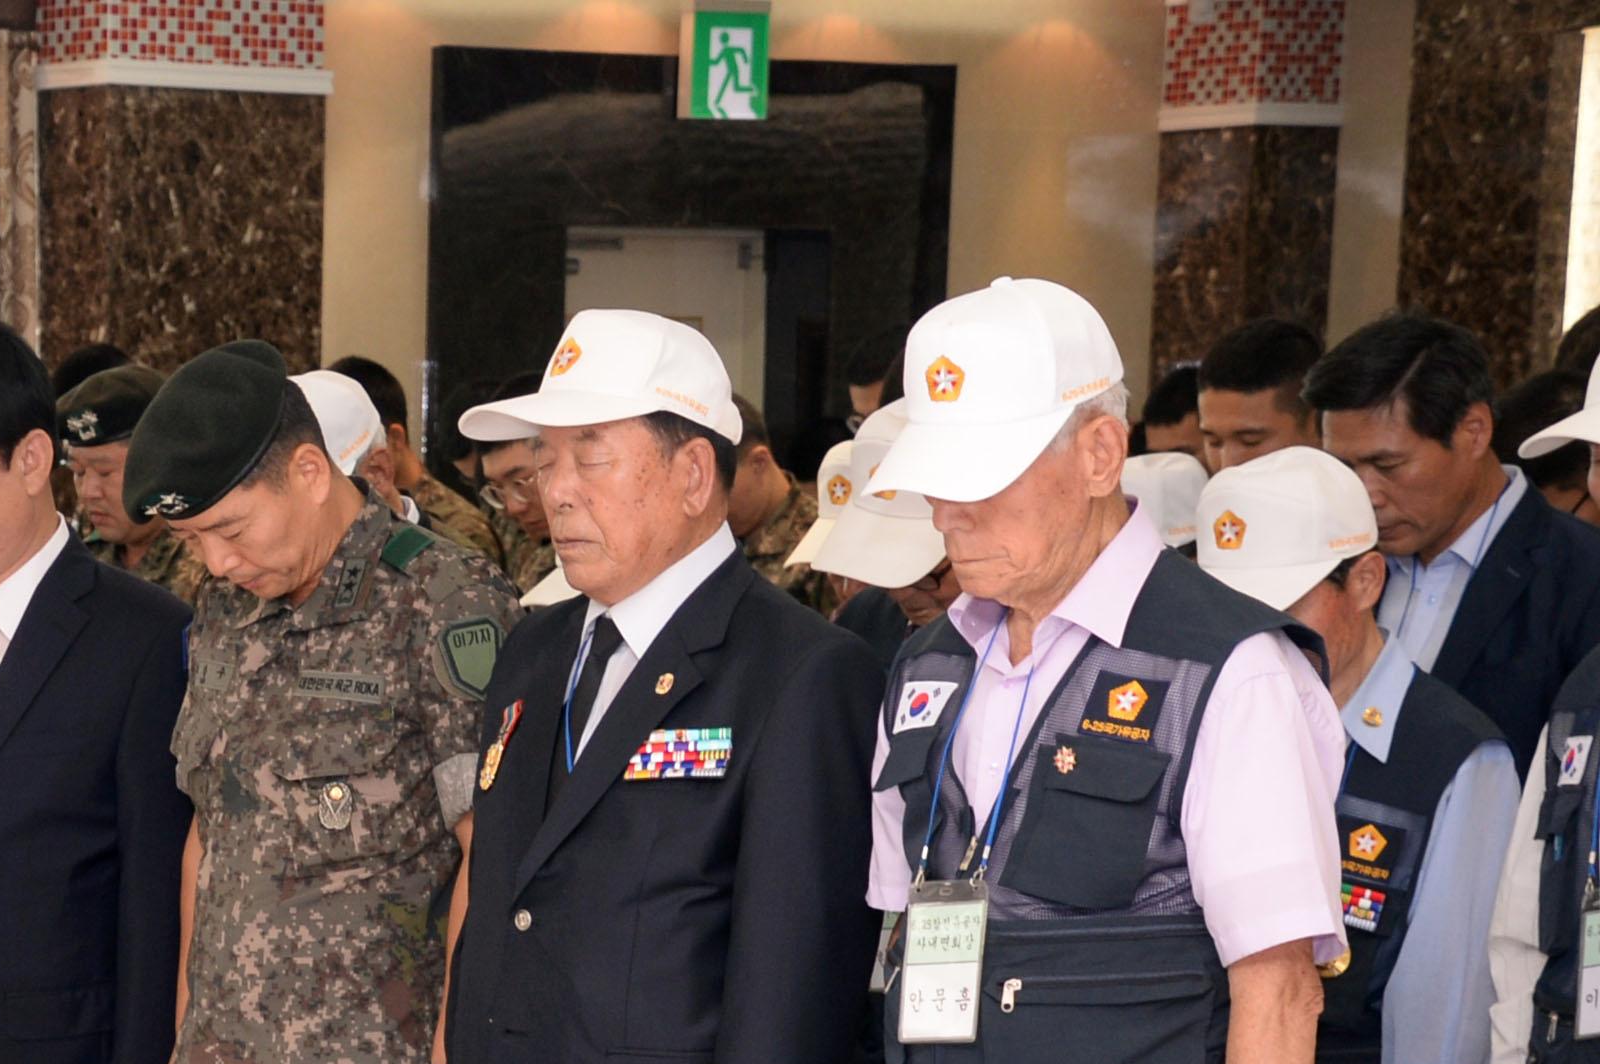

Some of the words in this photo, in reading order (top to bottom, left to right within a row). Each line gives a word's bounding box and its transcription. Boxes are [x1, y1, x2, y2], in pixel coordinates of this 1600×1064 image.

[453, 628, 491, 648] 이기자
[298, 677, 333, 691] 대한민국
[336, 680, 353, 693] 육군
[354, 681, 380, 695] ROKA
